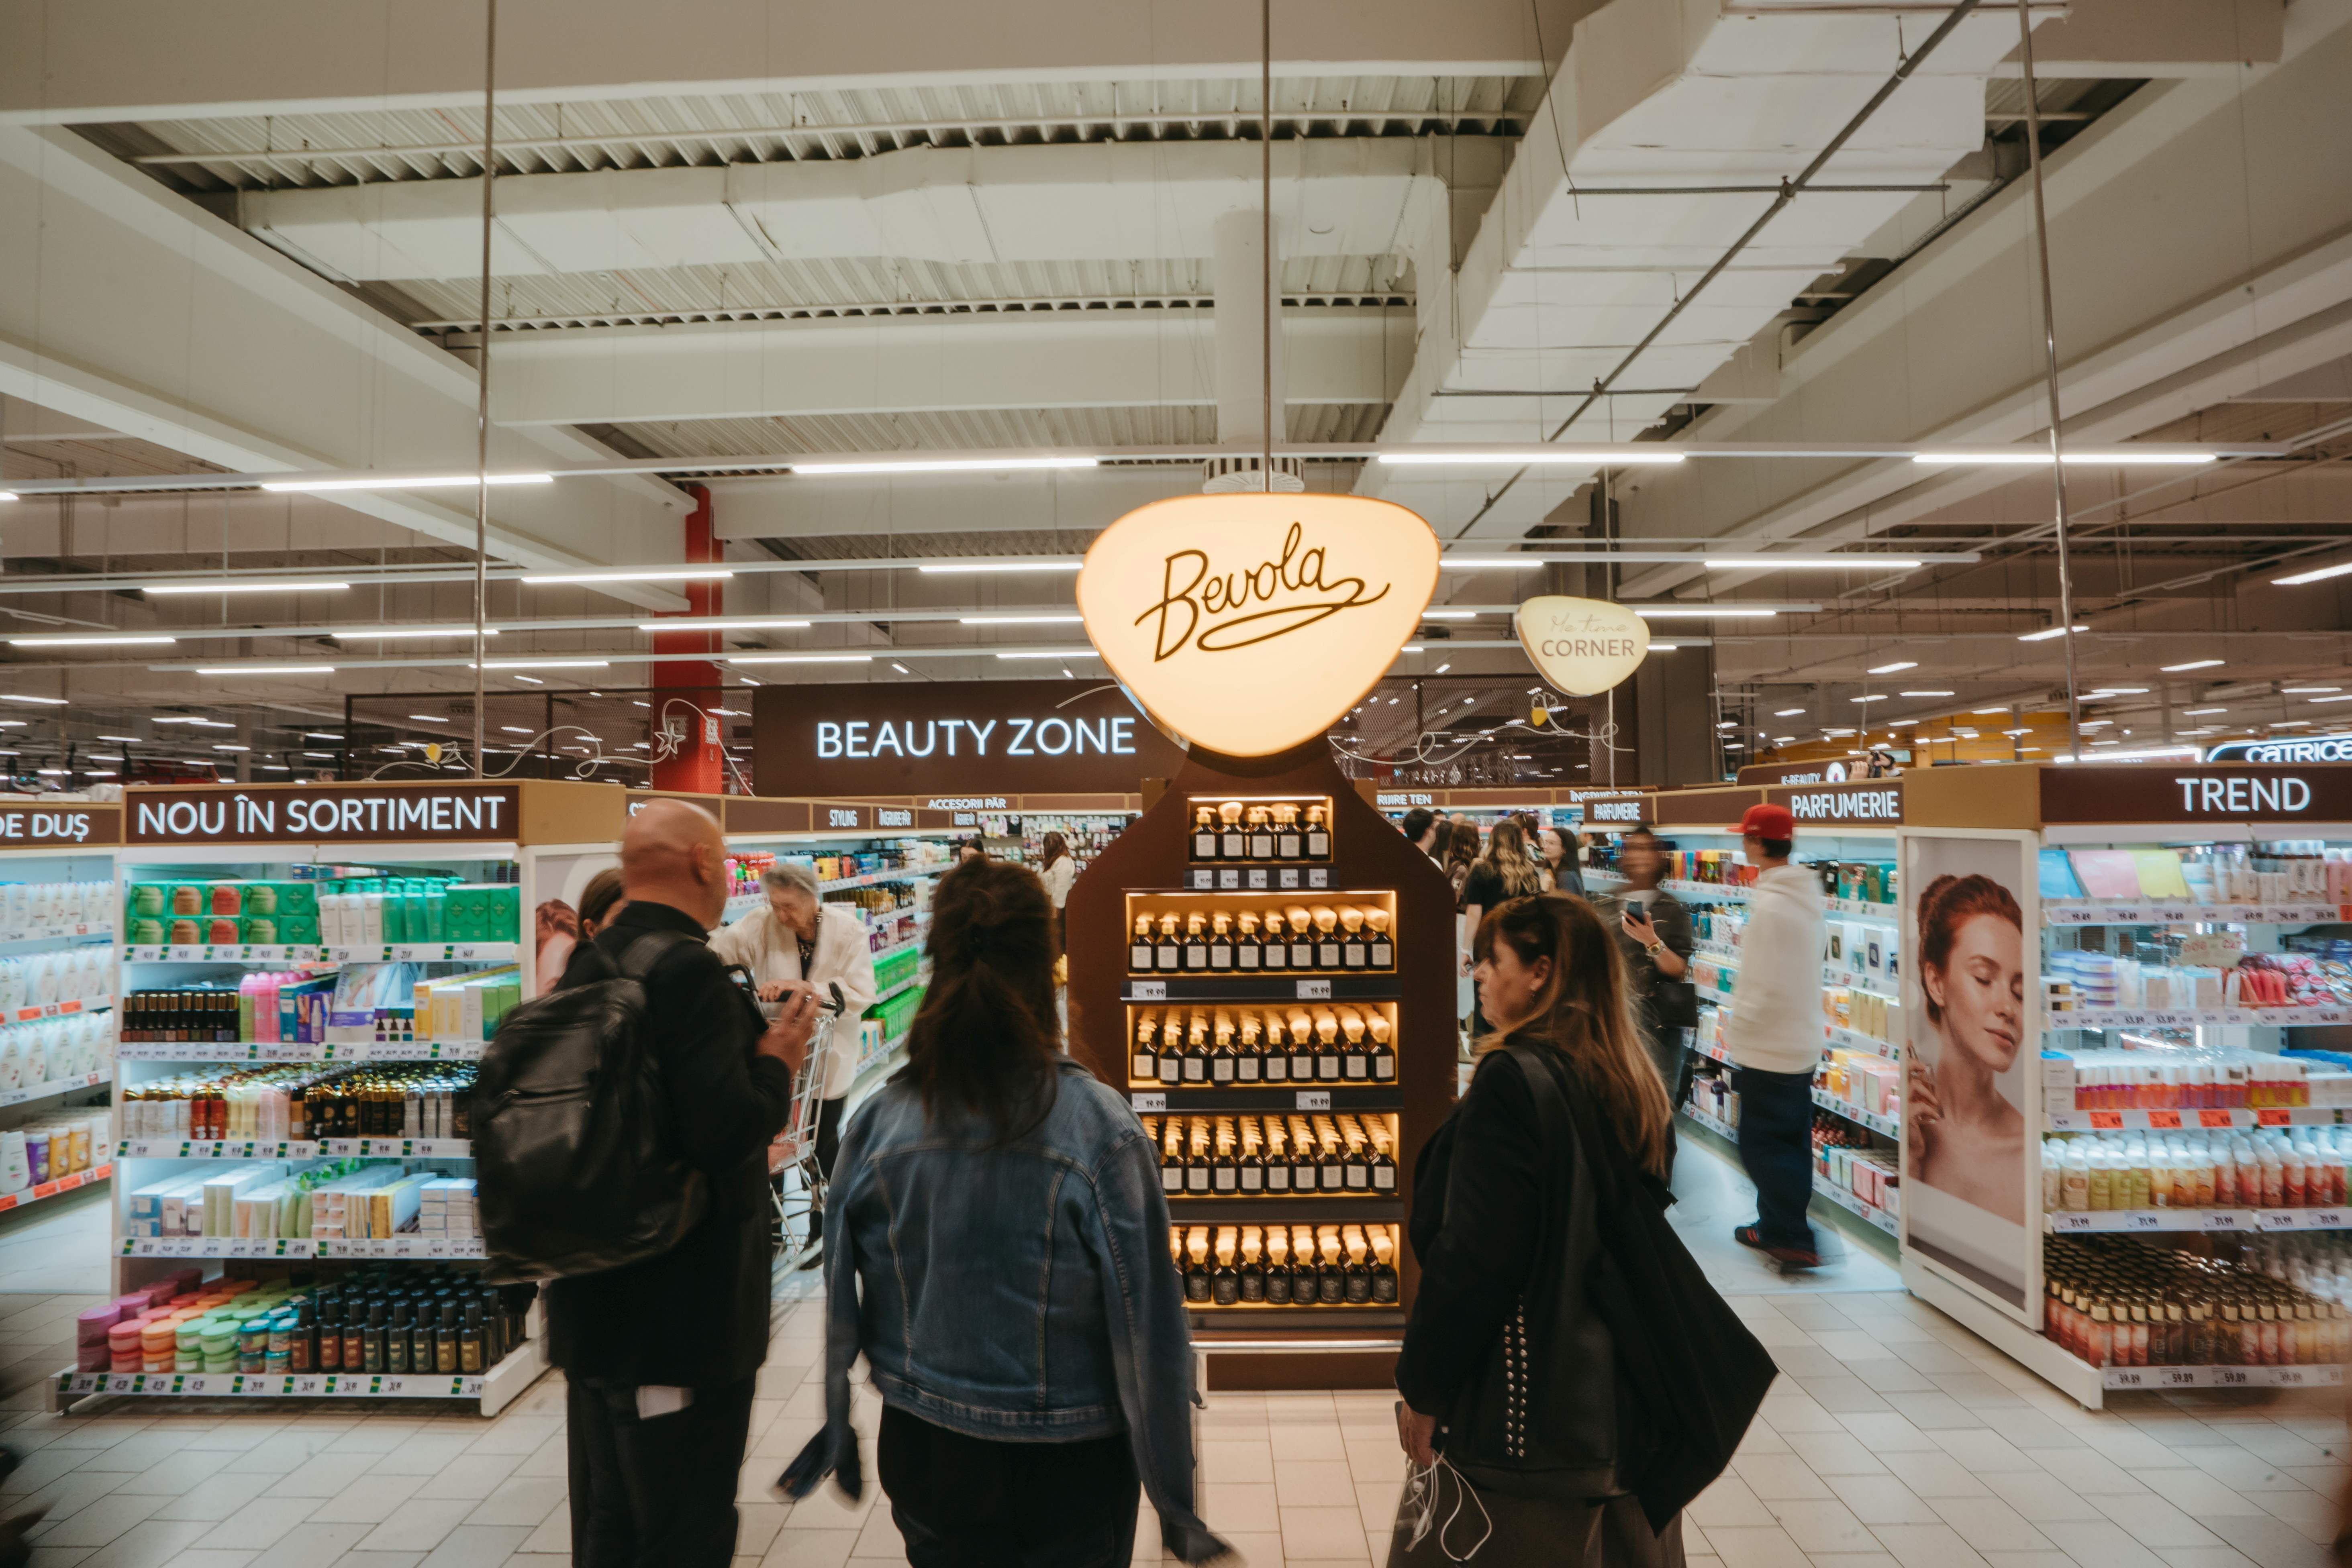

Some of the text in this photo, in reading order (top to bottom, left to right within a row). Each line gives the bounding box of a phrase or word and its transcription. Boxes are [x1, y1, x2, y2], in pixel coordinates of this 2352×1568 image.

[1135, 522, 1390, 662] Bevola
[1541, 639, 1635, 657] CORNER
[817, 718, 1136, 758] BEAUTY ZONE
[927, 797, 1006, 809] ACCESORII PĂR
[1408, 794, 1432, 805] TEN
[1791, 791, 1900, 818] PARFUMERIE
[2175, 778, 2311, 812] TREND
[138, 794, 506, 835] NOU ÎN SORTIMENT
[829, 809, 858, 827] STYLING
[1593, 802, 1641, 821] PARFUMERIE
[0, 813, 24, 839] E
[2172, 1373, 2193, 1383] 59.89
[2224, 1372, 2246, 1383] 59.89
